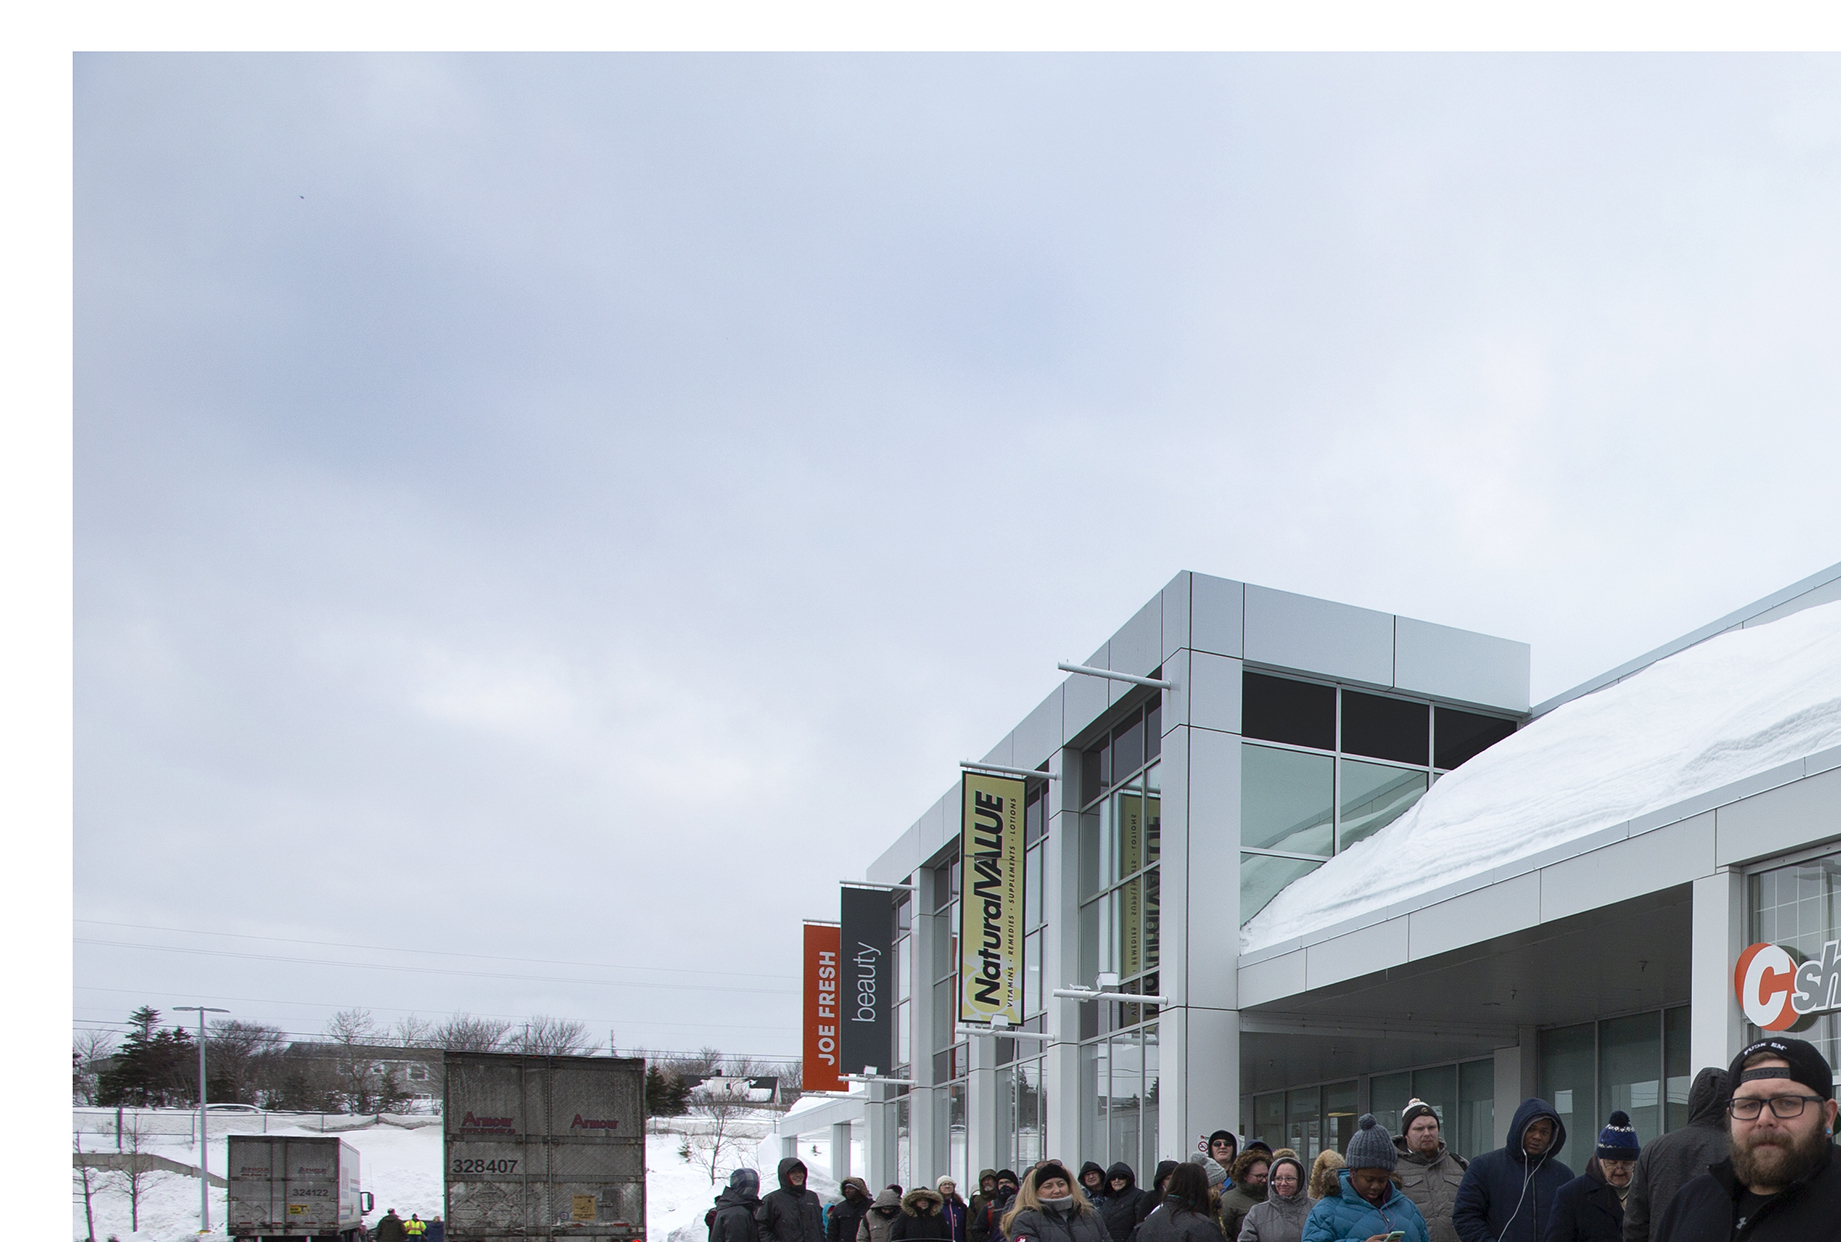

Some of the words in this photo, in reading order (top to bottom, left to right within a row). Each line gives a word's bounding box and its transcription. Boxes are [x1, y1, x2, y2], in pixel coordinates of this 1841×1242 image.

[1009, 797, 1017, 835] LOTIONS
[1008, 845, 1016, 904] SUPPLEMENTS
[973, 789, 1004, 1007] NaturalVALUE
[1007, 914, 1015, 956] REMEDIES
[818, 951, 836, 1018] FRESH
[851, 941, 882, 1022] beauty
[1006, 965, 1015, 1008] VITAMINS
[1743, 944, 1791, 1027] C
[817, 1024, 836, 1066] JOE
[460, 1110, 514, 1128] Armour
[570, 1113, 620, 1130] Armour
[452, 1158, 519, 1174] 328407
[292, 1188, 329, 1197] 324122
